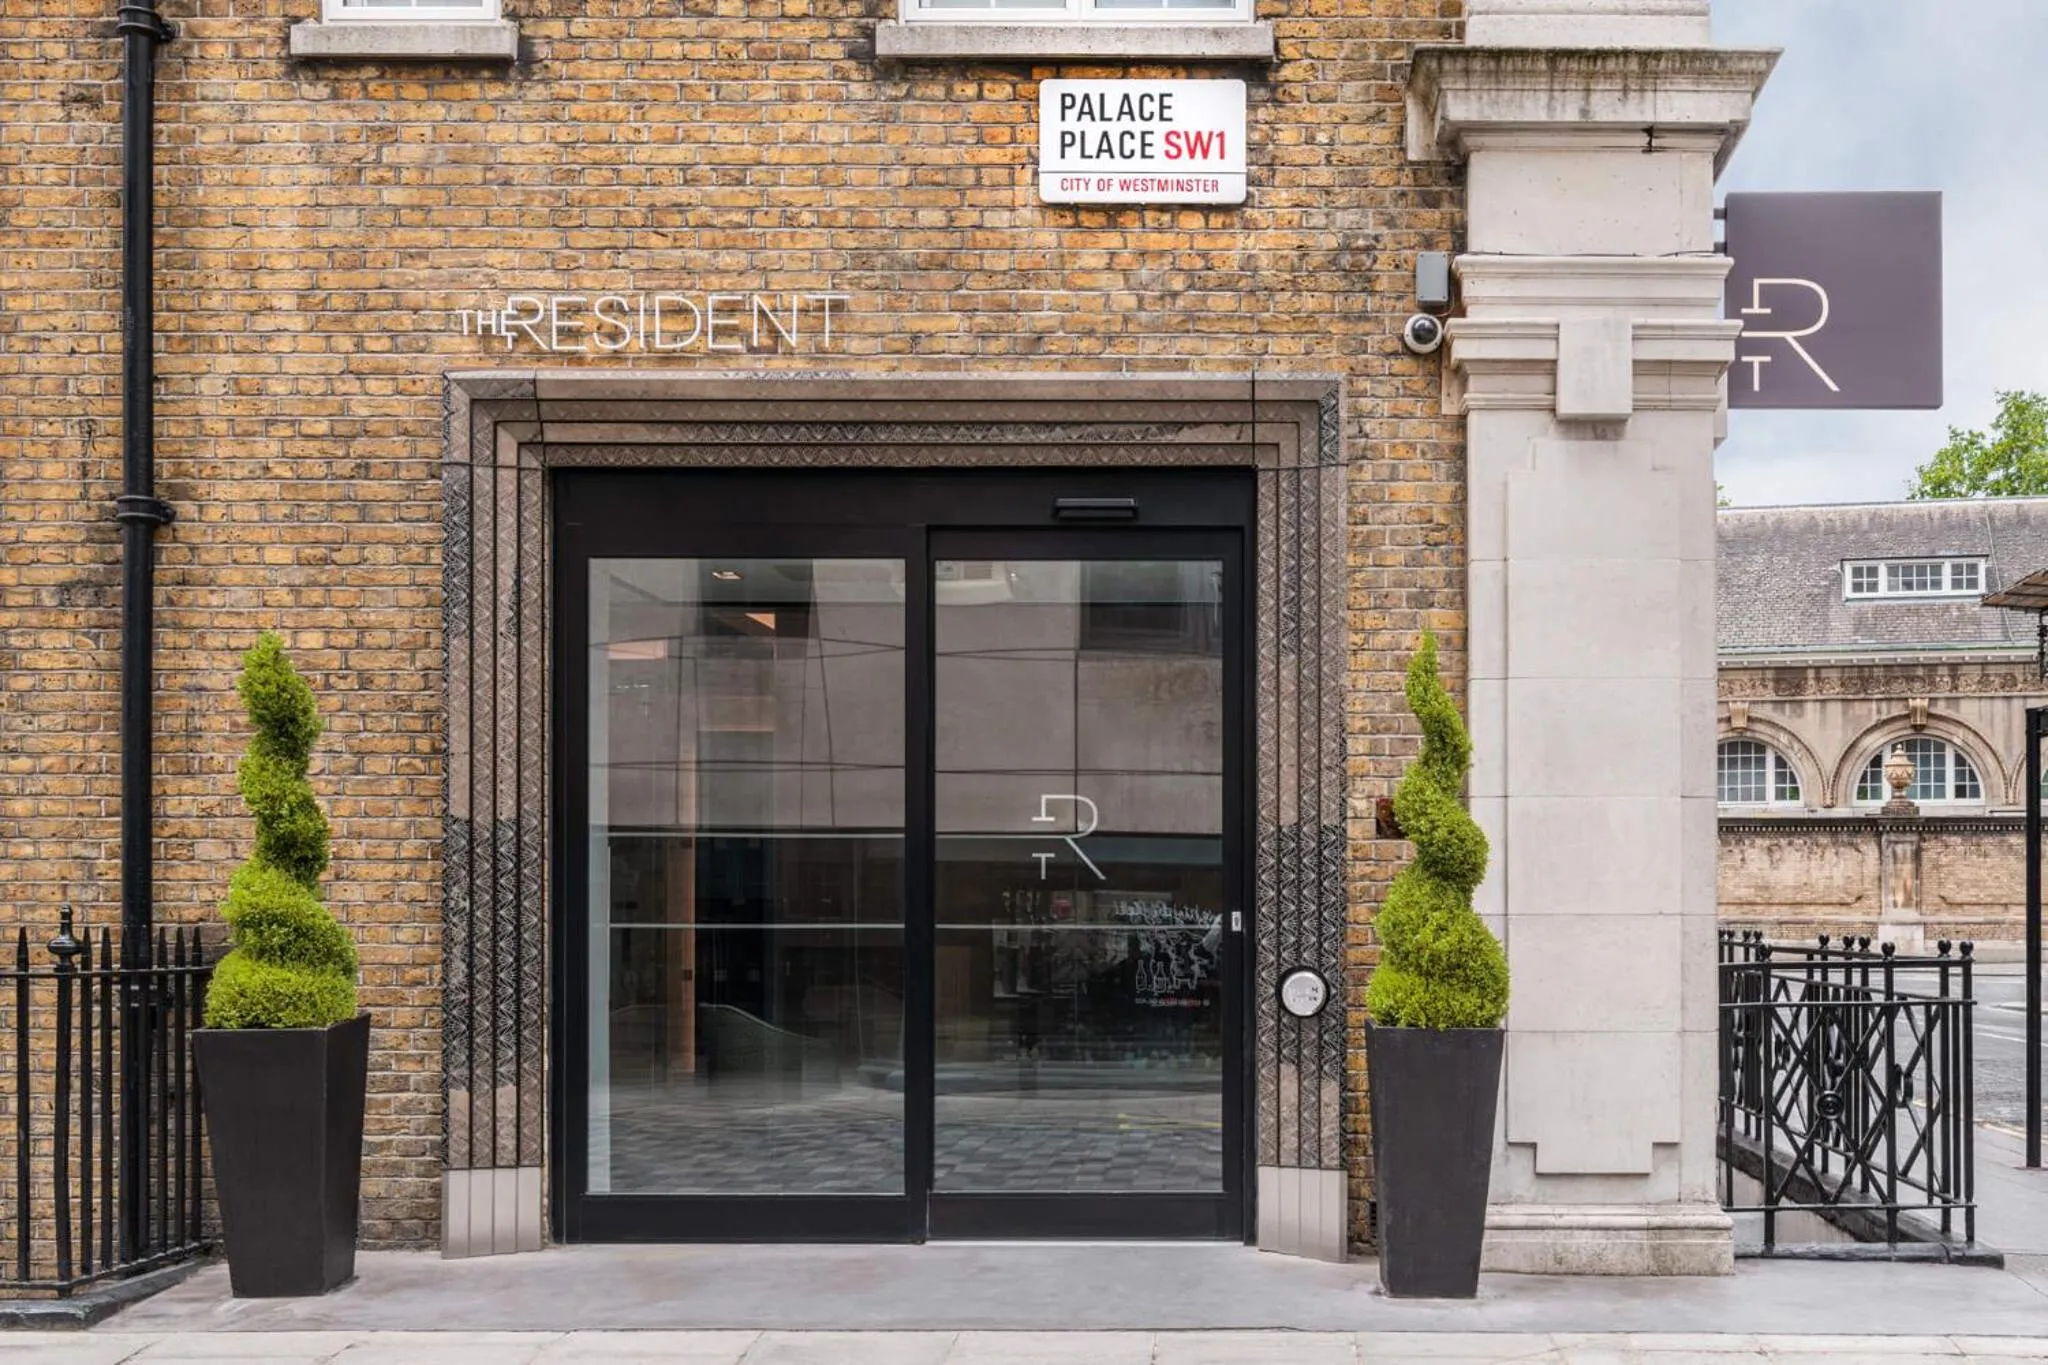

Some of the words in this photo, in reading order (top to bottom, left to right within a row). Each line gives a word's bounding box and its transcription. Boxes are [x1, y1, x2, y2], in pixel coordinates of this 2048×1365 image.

[1060, 92, 1173, 122] PALACE
[1060, 130, 1155, 160] PLACE
[1164, 130, 1226, 160] SW1
[1060, 178, 1091, 192] CITY
[1097, 178, 1114, 192] OF
[1119, 178, 1219, 193] WESTMINSTER
[456, 309, 518, 336] THE
[506, 295, 851, 351] RESIDENT
